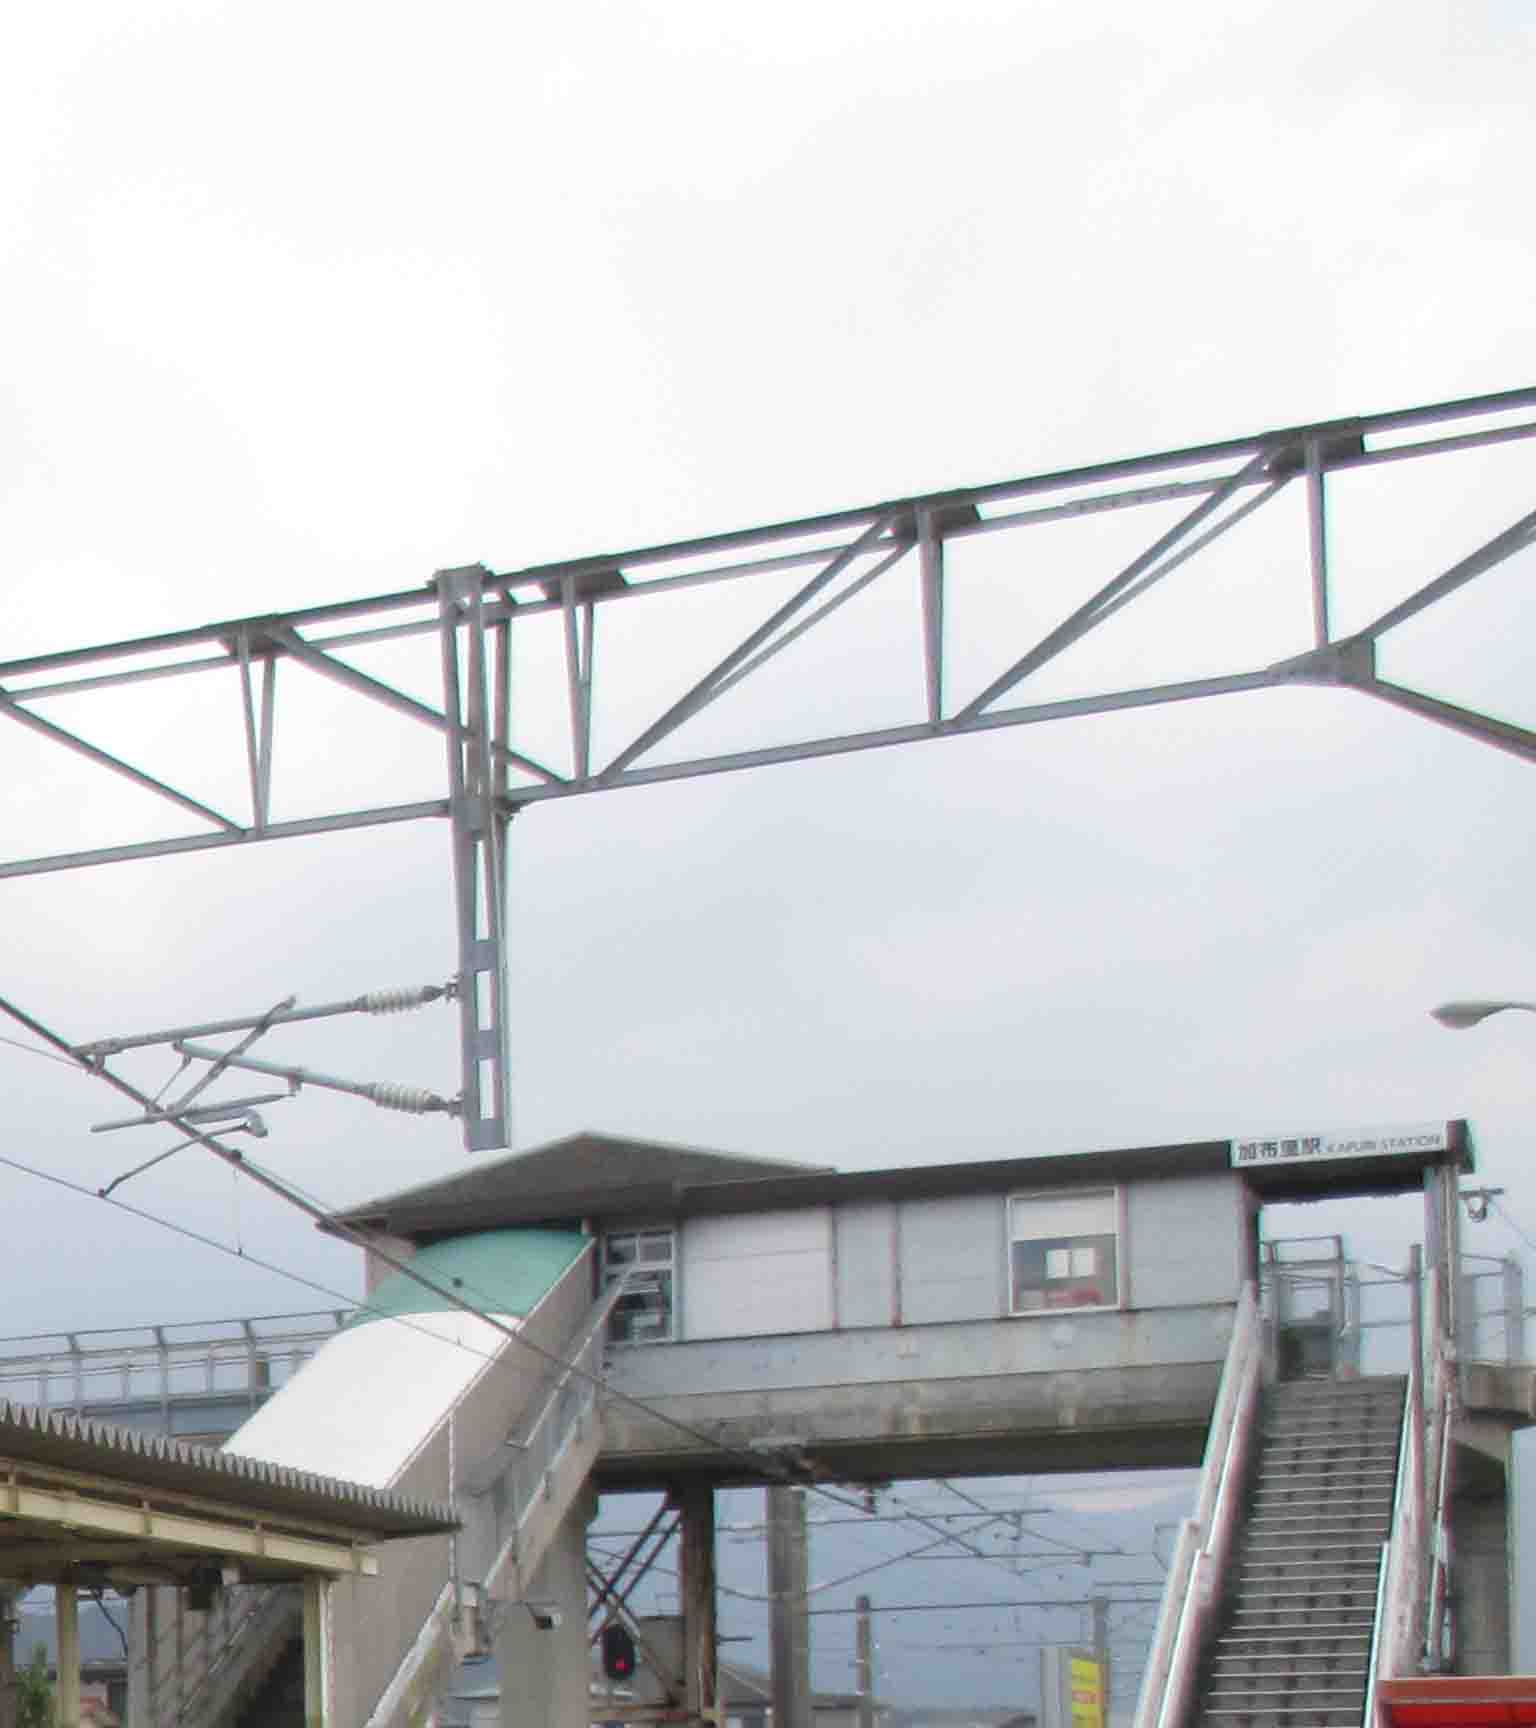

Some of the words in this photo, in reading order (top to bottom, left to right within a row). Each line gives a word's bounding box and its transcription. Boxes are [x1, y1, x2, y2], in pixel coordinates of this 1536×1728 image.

[1237, 1137, 1321, 1161] 加布里駅
[1382, 1134, 1440, 1151] STATION
